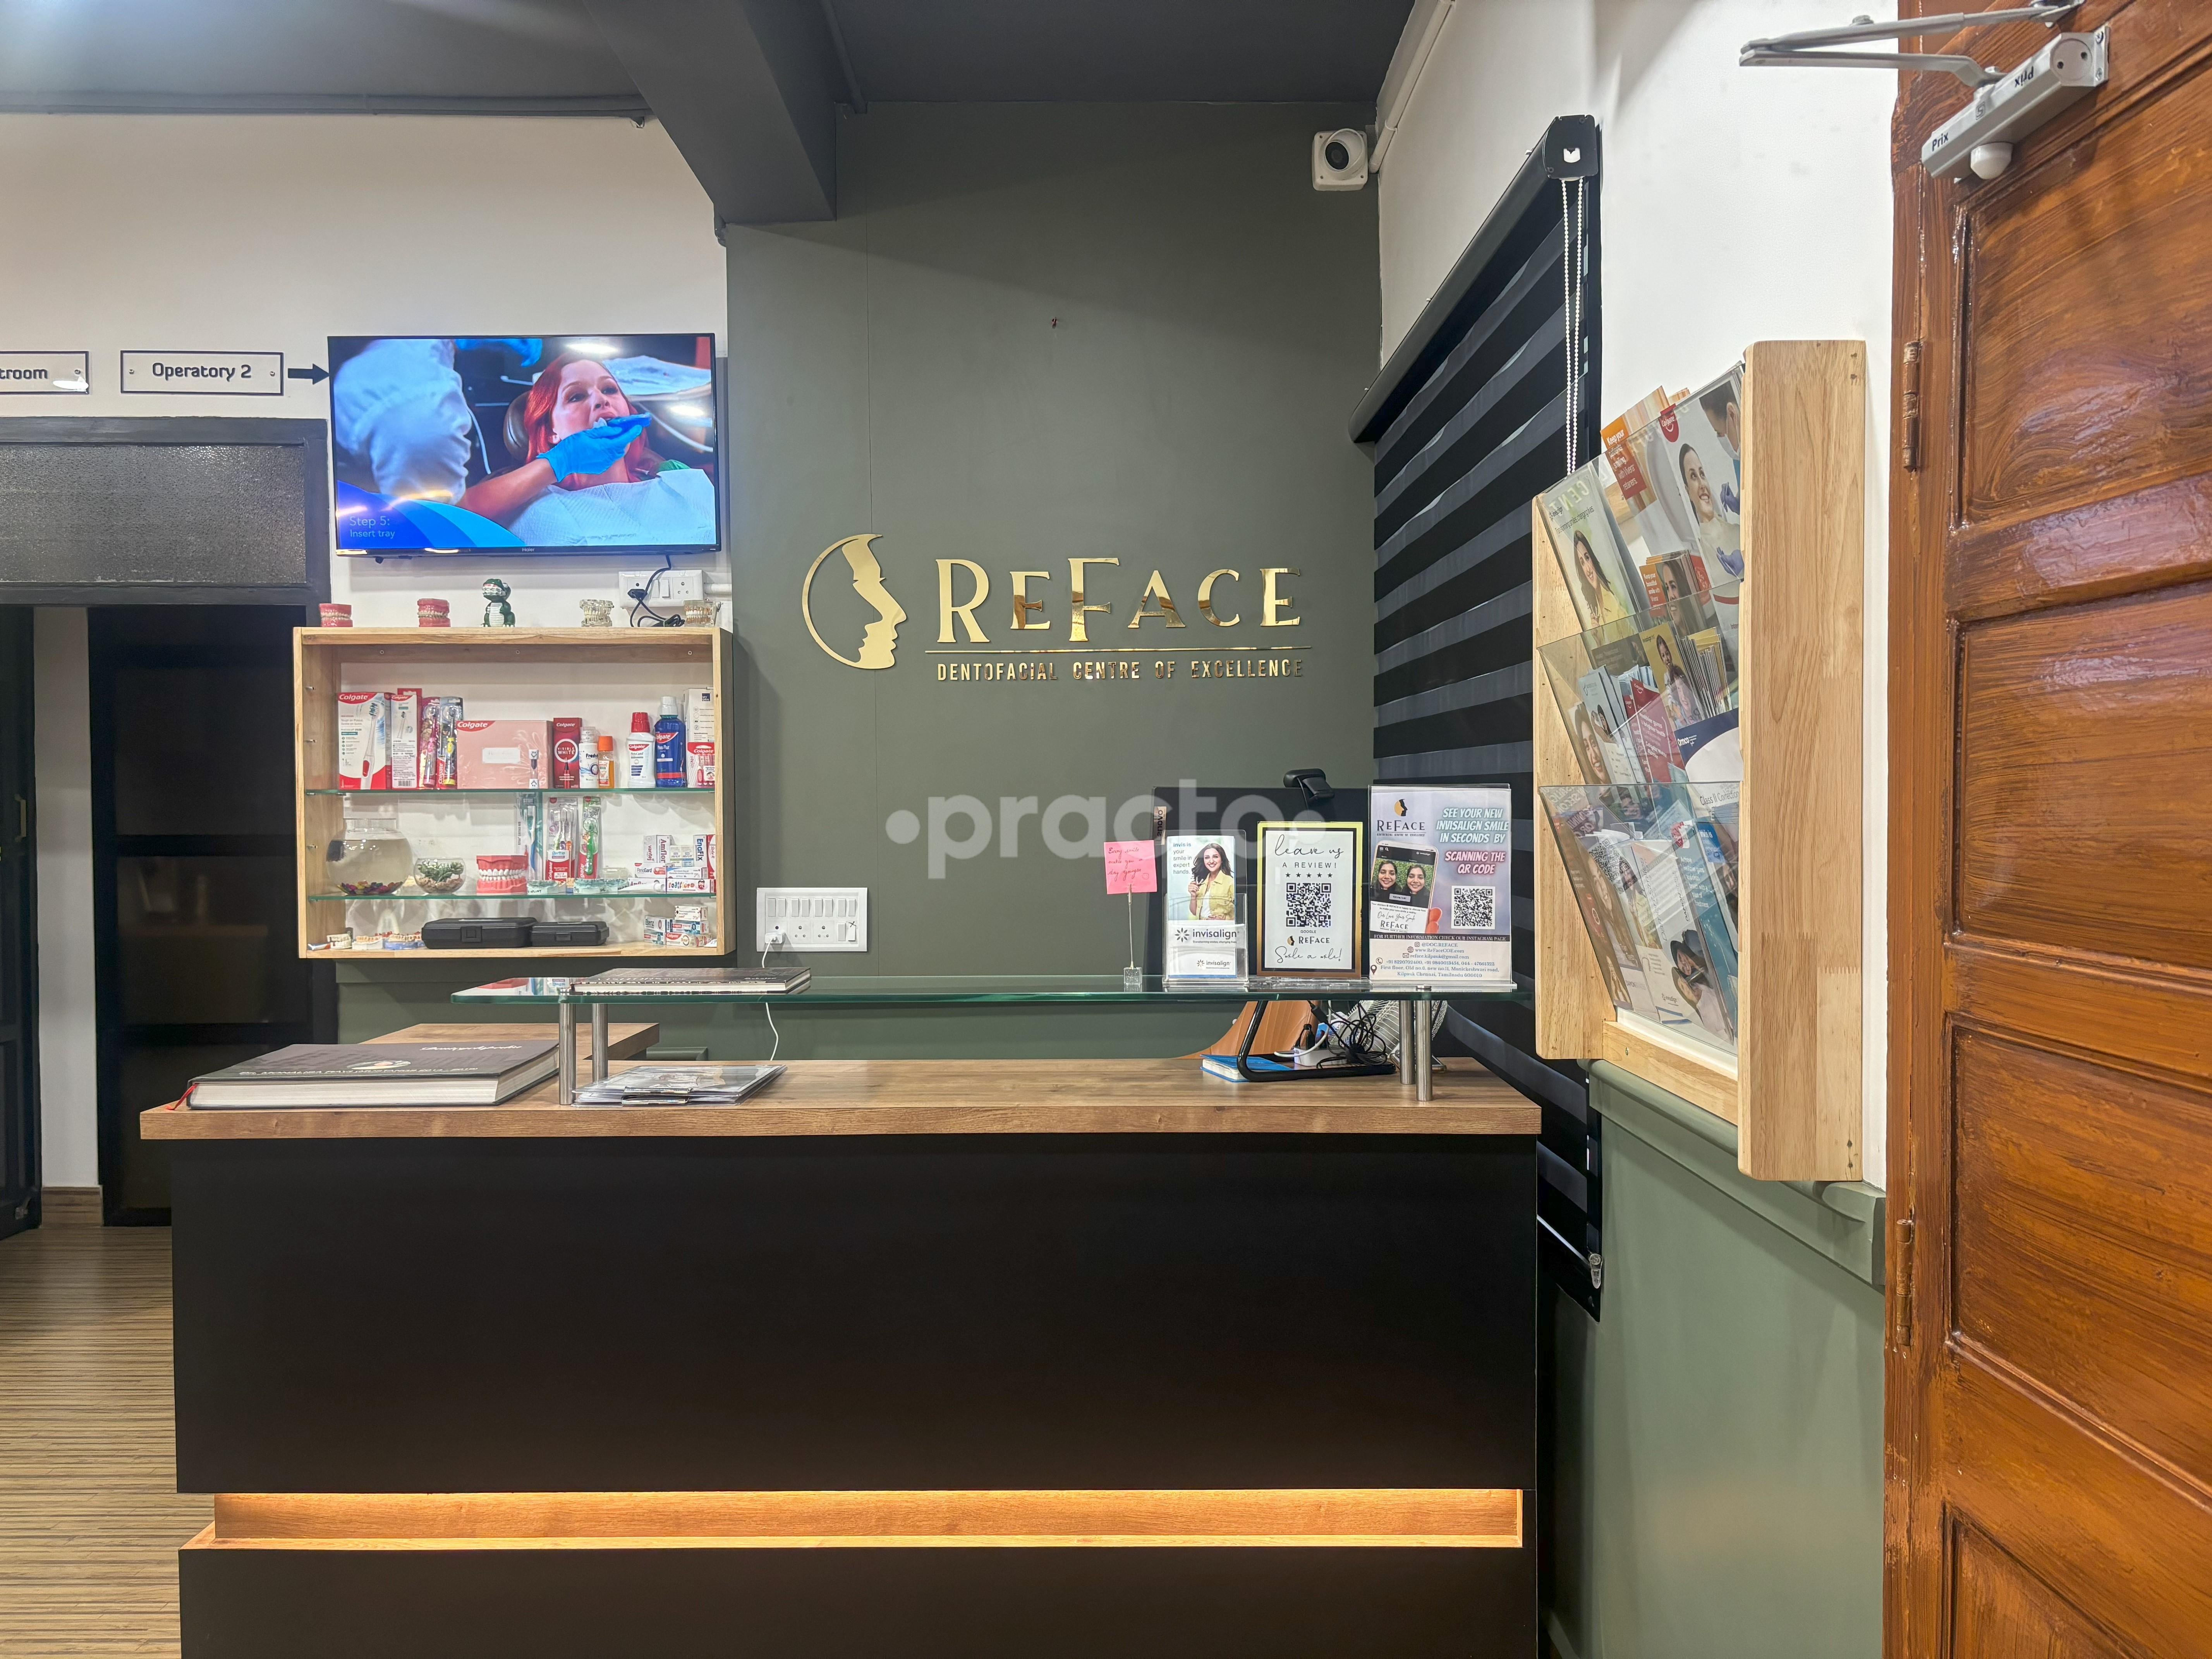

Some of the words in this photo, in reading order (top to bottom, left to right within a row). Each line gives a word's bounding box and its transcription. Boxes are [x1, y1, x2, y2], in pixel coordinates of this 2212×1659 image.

[2014, 66, 2034, 88] Prix
[1932, 132, 1949, 151] Prix
[0, 368, 48, 380] troom
[152, 362, 235, 382] Operatory
[241, 364, 252, 378] 2
[1661, 416, 1675, 427] Colgate
[1606, 435, 1617, 446] Keep
[1616, 429, 1625, 442] your
[350, 516, 376, 527] Step
[380, 516, 390, 526] 5:
[378, 530, 395, 539] tray
[937, 663, 1058, 682] DENTOFACIAL
[1073, 661, 1140, 680] CENTRE
[1155, 660, 1175, 679] OF
[1191, 659, 1303, 678] EXCELLENCE
[1677, 737, 1690, 747] Ormco
[1700, 796, 1714, 805] Class
[1714, 794, 1717, 802] II
[1717, 790, 1739, 802] Correction
[1443, 808, 1458, 818] SEE
[1460, 808, 1482, 818] YOUR
[1484, 808, 1503, 818] NEW
[1436, 820, 1483, 830] INVISALIGN
[1484, 821, 1509, 831] SMILE
[1440, 833, 1449, 842] IN
[1451, 833, 1490, 843] SECONDS
[1493, 834, 1506, 843] BY
[1275, 834, 1324, 855] leave
[1329, 848, 1344, 859] us
[1109, 847, 1121, 859] Every
[1445, 851, 1488, 862] SCANNING
[1491, 852, 1506, 862] THE
[1458, 864, 1471, 874] QR
[1473, 864, 1495, 874] CODE
[1108, 869, 1118, 881] day
[1193, 929, 1236, 939] invisalign
